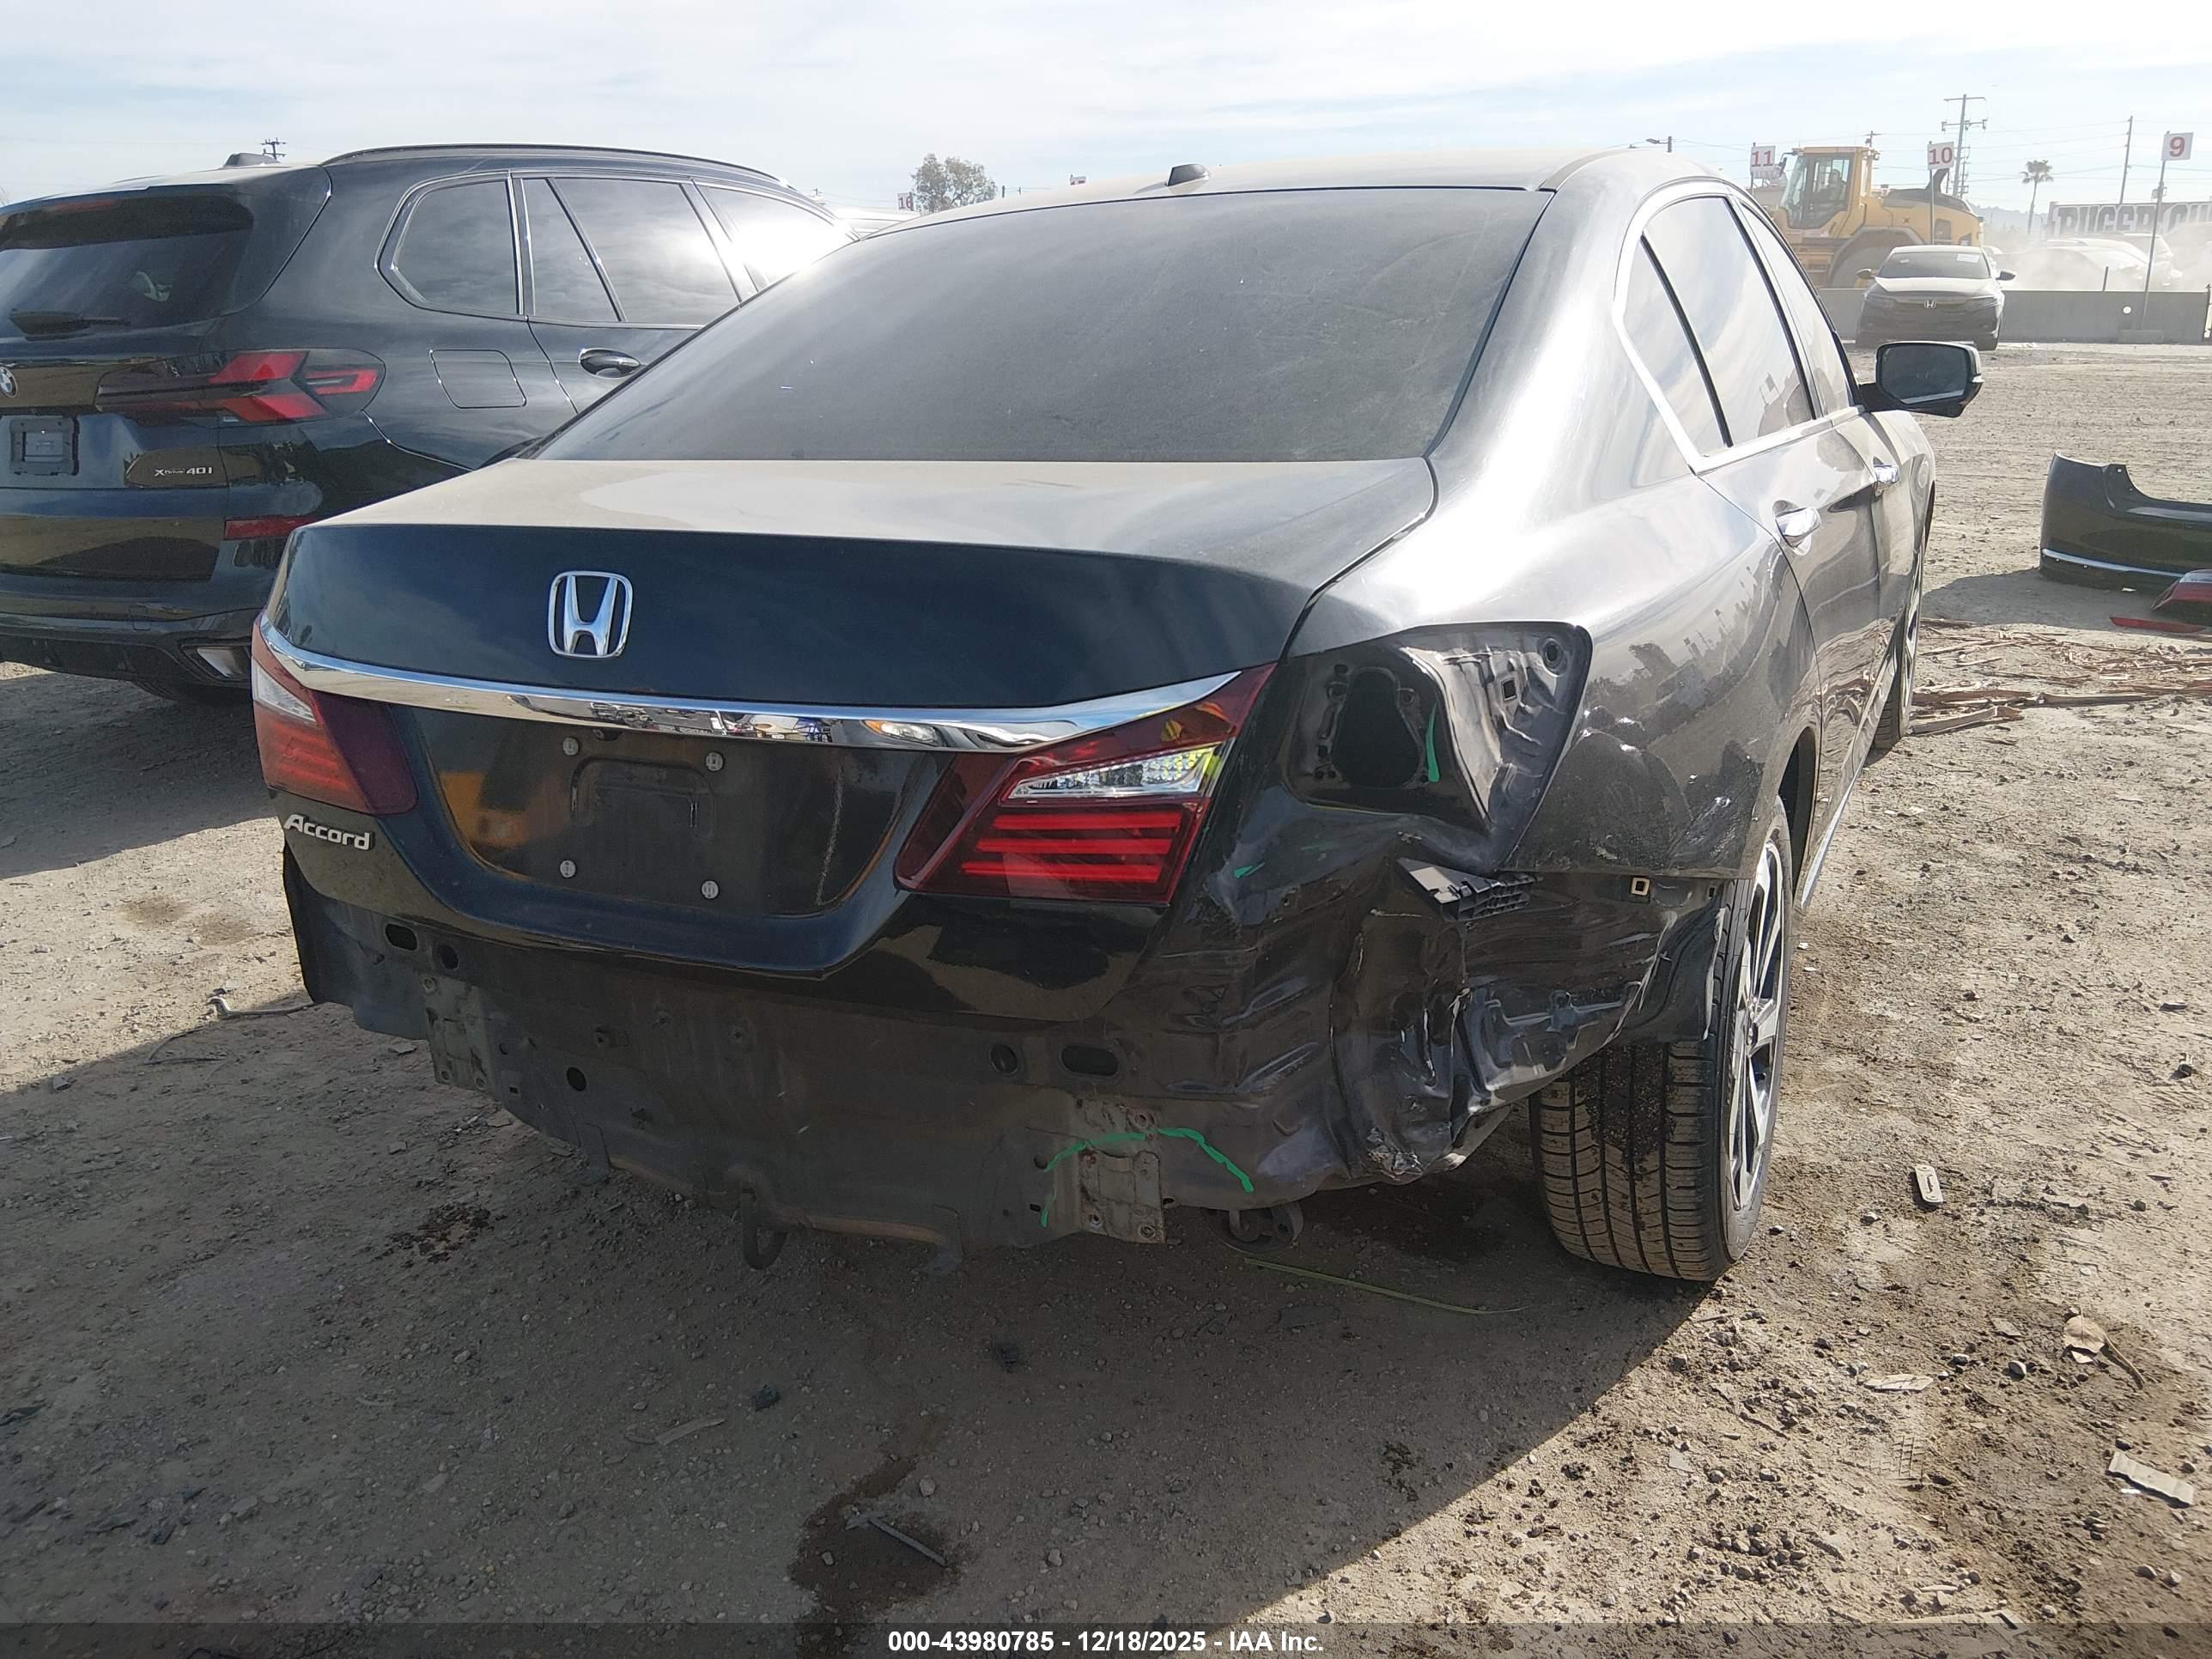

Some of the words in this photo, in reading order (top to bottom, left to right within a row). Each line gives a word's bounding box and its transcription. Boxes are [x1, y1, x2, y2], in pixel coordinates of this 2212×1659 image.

[1929, 146, 1953, 166] 10
[2169, 136, 2185, 157] 9
[1752, 150, 1773, 167] 11
[283, 812, 371, 851] Accord
